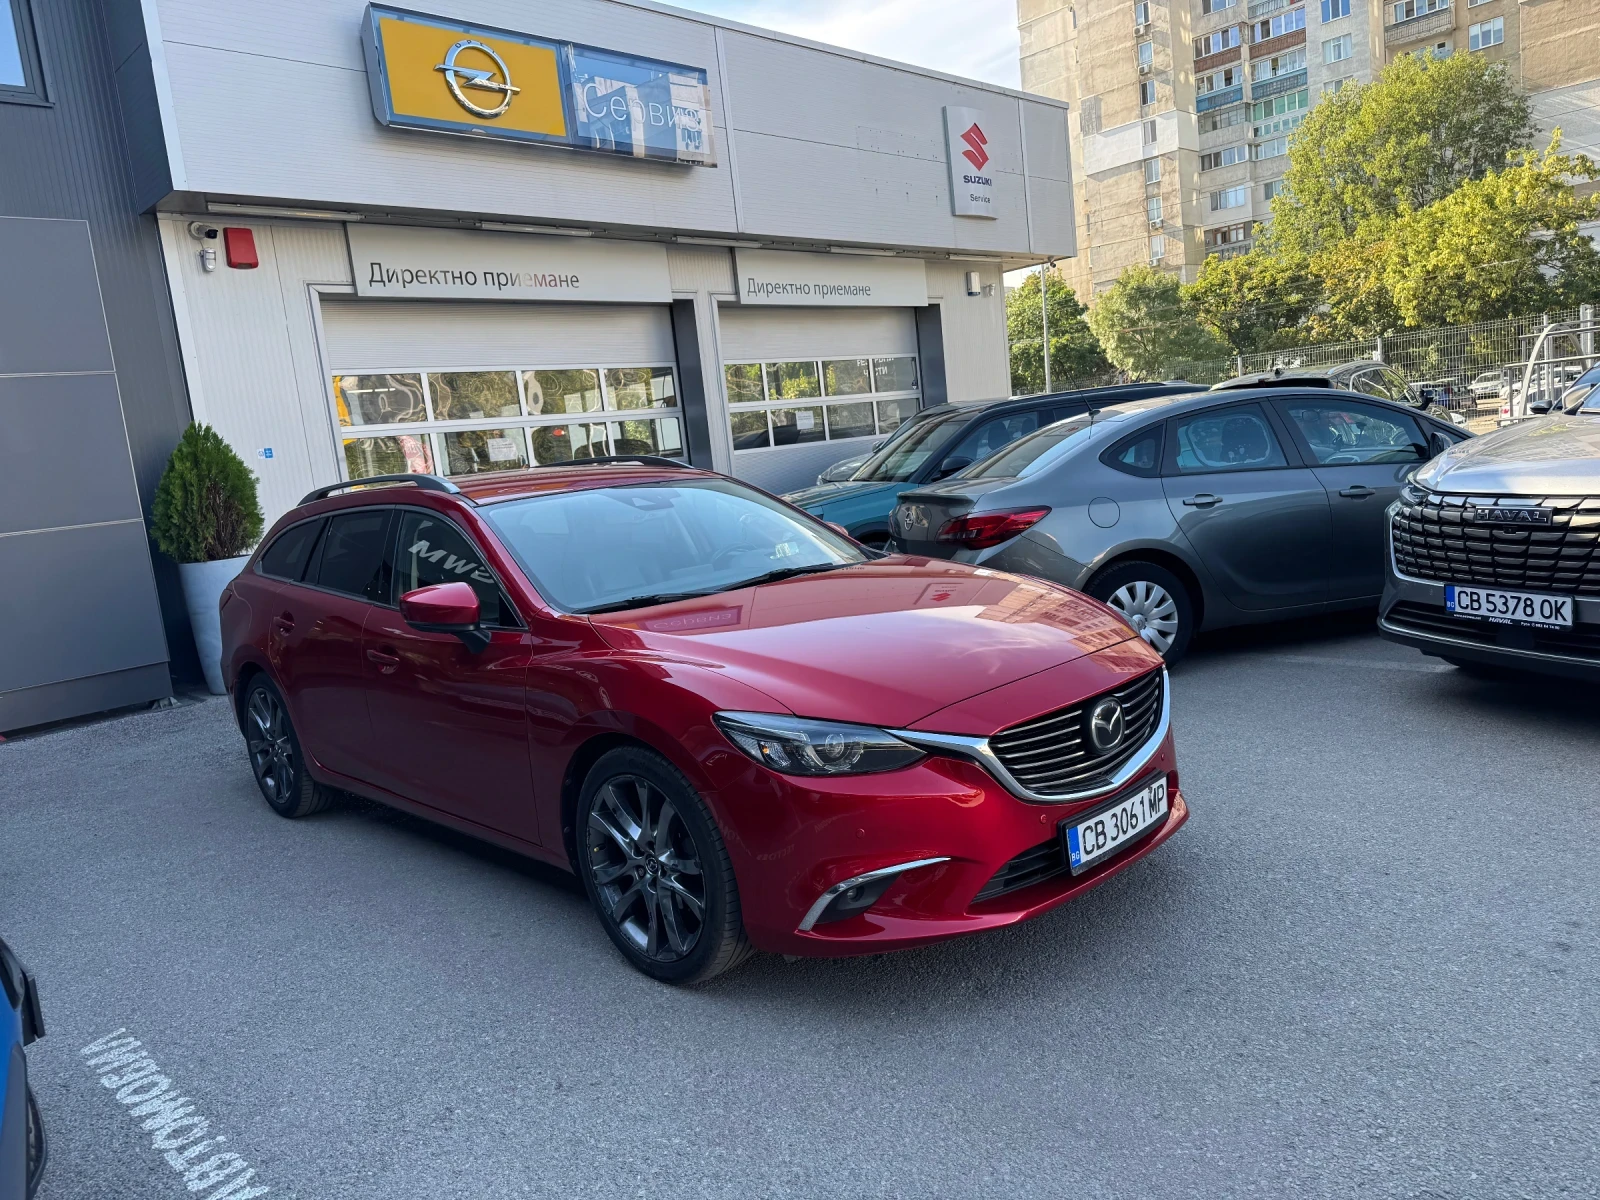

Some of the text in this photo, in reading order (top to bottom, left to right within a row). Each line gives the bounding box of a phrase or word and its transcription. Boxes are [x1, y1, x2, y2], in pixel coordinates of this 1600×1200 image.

[583, 83, 701, 131] Сервиз
[963, 174, 993, 187] SUZUKI
[970, 193, 991, 204] Service
[369, 262, 580, 291] Директно приемане
[747, 277, 871, 299] Директно приемане
[1476, 509, 1547, 523] HAVAL
[1457, 590, 1568, 623] CB 5378 OK
[1488, 616, 1513, 626] HAVAL
[1082, 783, 1166, 856] CB 3061 MP
[1071, 850, 1080, 862] BG
